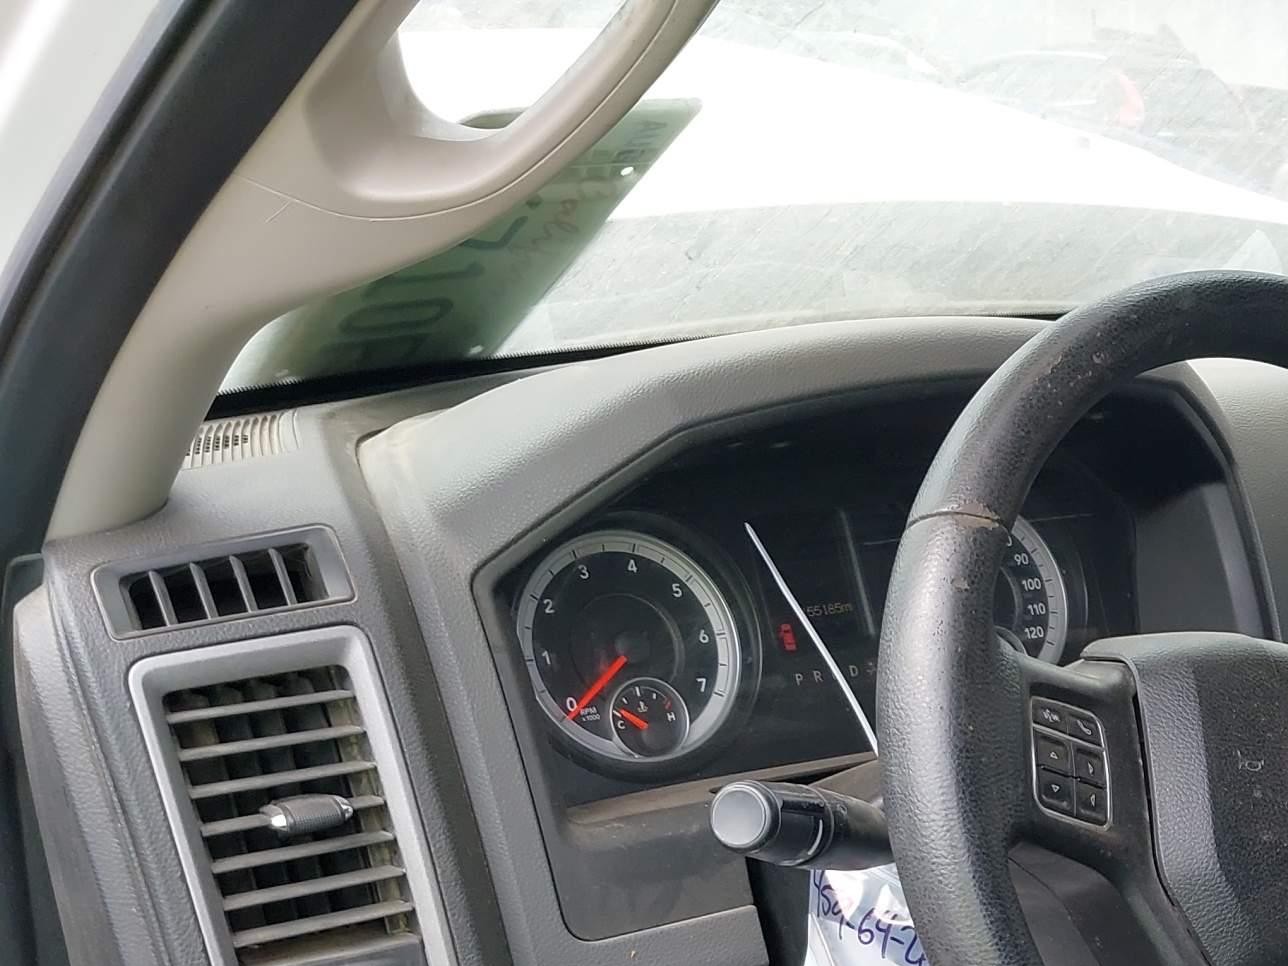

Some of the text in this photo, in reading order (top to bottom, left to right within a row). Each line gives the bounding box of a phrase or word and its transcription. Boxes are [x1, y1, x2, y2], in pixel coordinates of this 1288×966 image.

[627, 559, 638, 573] 4
[1014, 553, 1029, 566] 90
[578, 564, 590, 579] 3
[672, 583, 683, 598] 5
[1021, 578, 1042, 592] 100
[543, 599, 555, 614] 2
[1027, 602, 1046, 616] 110
[698, 630, 710, 643] 6
[1024, 626, 1044, 640] 120
[542, 650, 551, 665] 1
[795, 665, 859, 686] P R D
[696, 678, 707, 693] 7
[566, 697, 578, 712] 0
[580, 706, 598, 716] RPM
[667, 711, 676, 722] H
[617, 720, 626, 730] C
